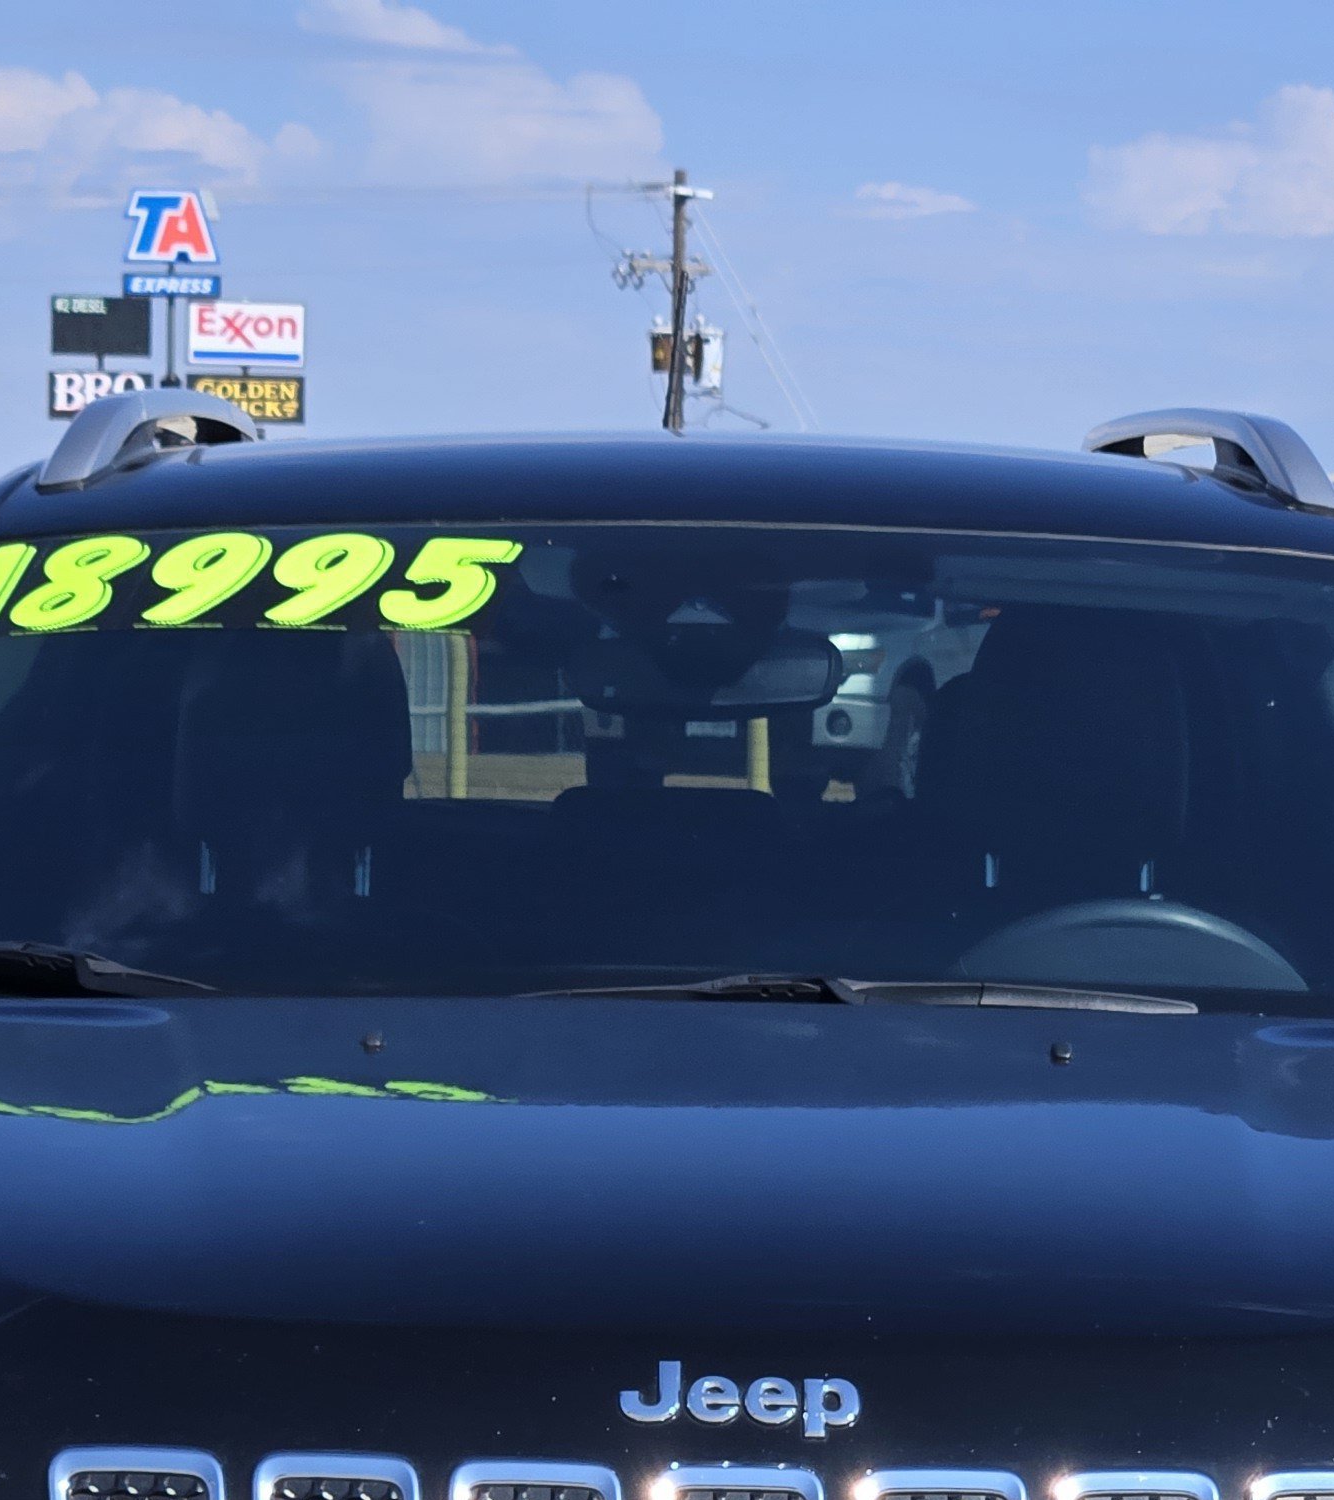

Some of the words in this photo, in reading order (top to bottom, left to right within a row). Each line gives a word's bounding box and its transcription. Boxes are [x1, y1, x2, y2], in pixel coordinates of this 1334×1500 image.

[129, 191, 216, 260] TA
[130, 277, 213, 293] EXPRESS
[197, 305, 297, 349] Exxon
[195, 378, 299, 400] GOLDEN
[619, 1360, 861, 1437] Jeep
